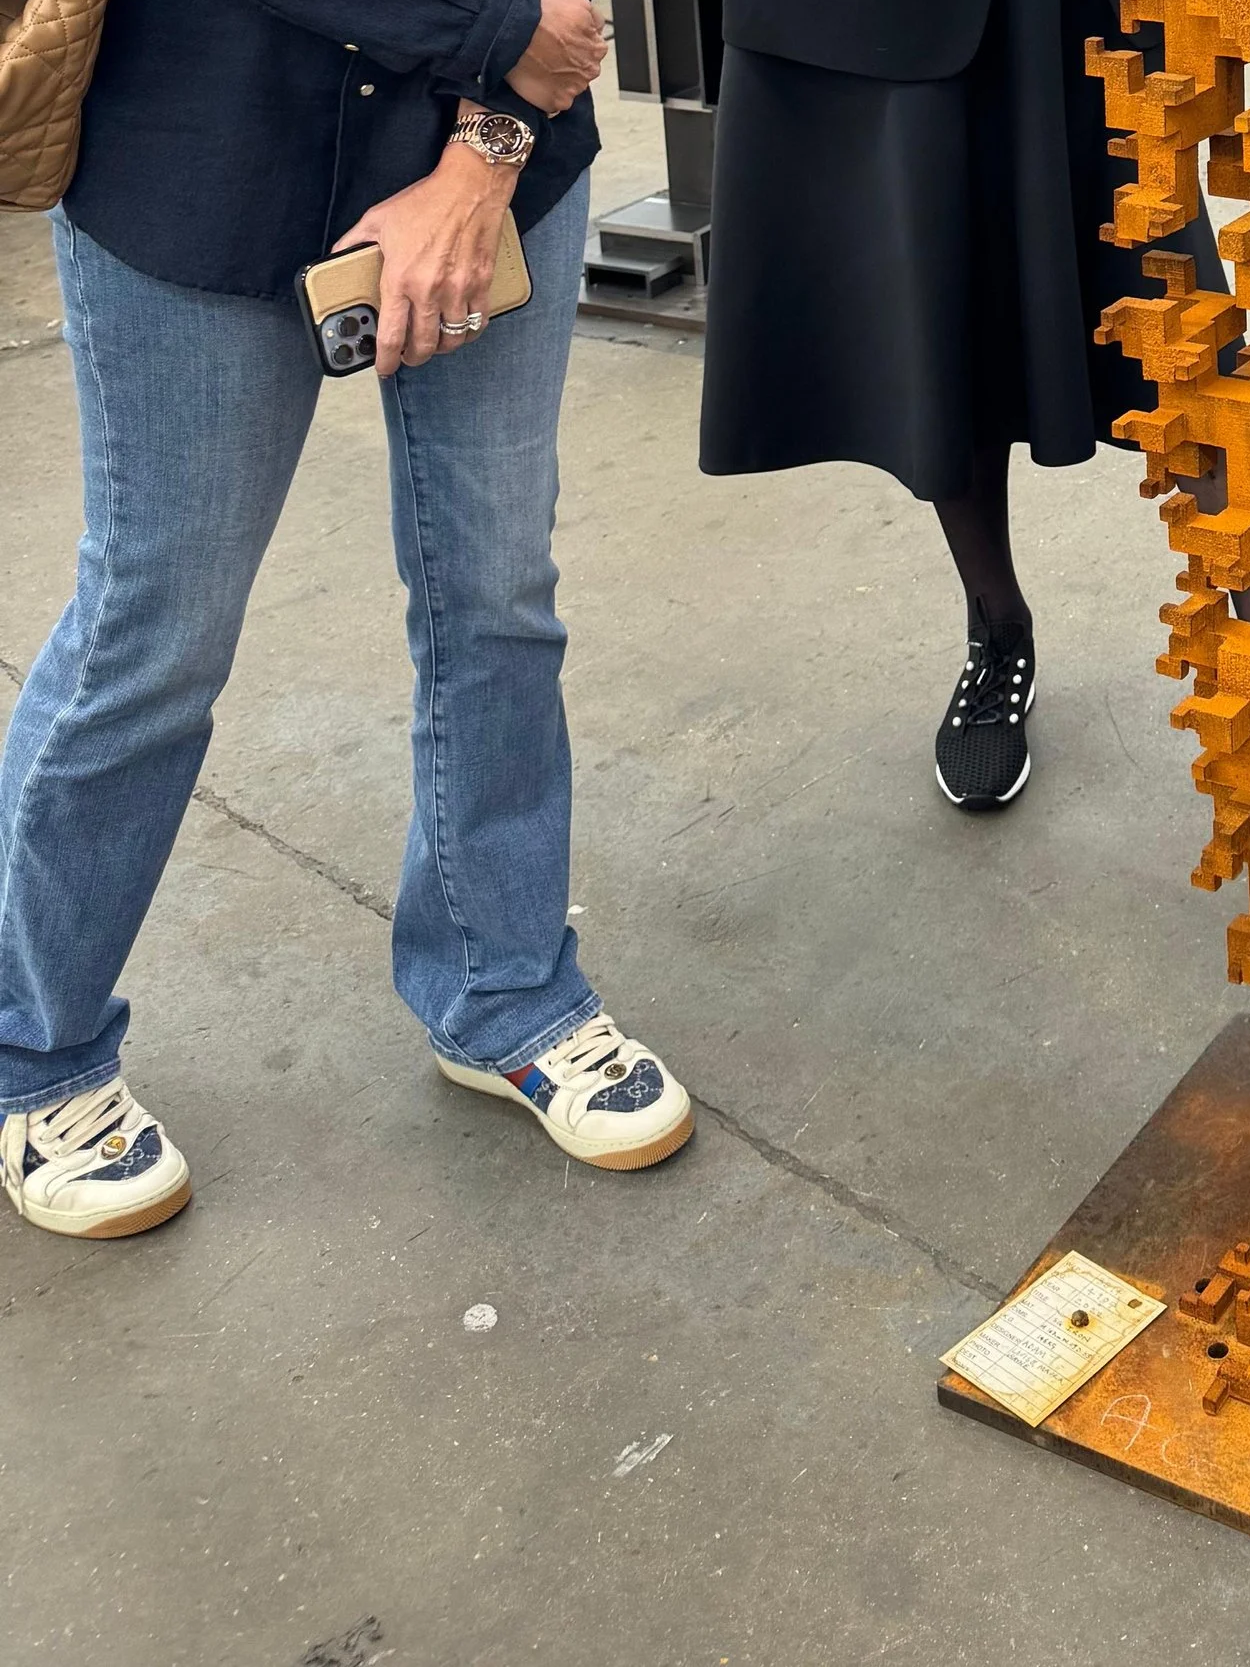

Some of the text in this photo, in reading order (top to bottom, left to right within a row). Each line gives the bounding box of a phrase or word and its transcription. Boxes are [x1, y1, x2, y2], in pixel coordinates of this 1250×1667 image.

[979, 1331, 1001, 1348] MAKER
[991, 1322, 1022, 1345] DESIGNER
[969, 1339, 991, 1356] PHOTO
